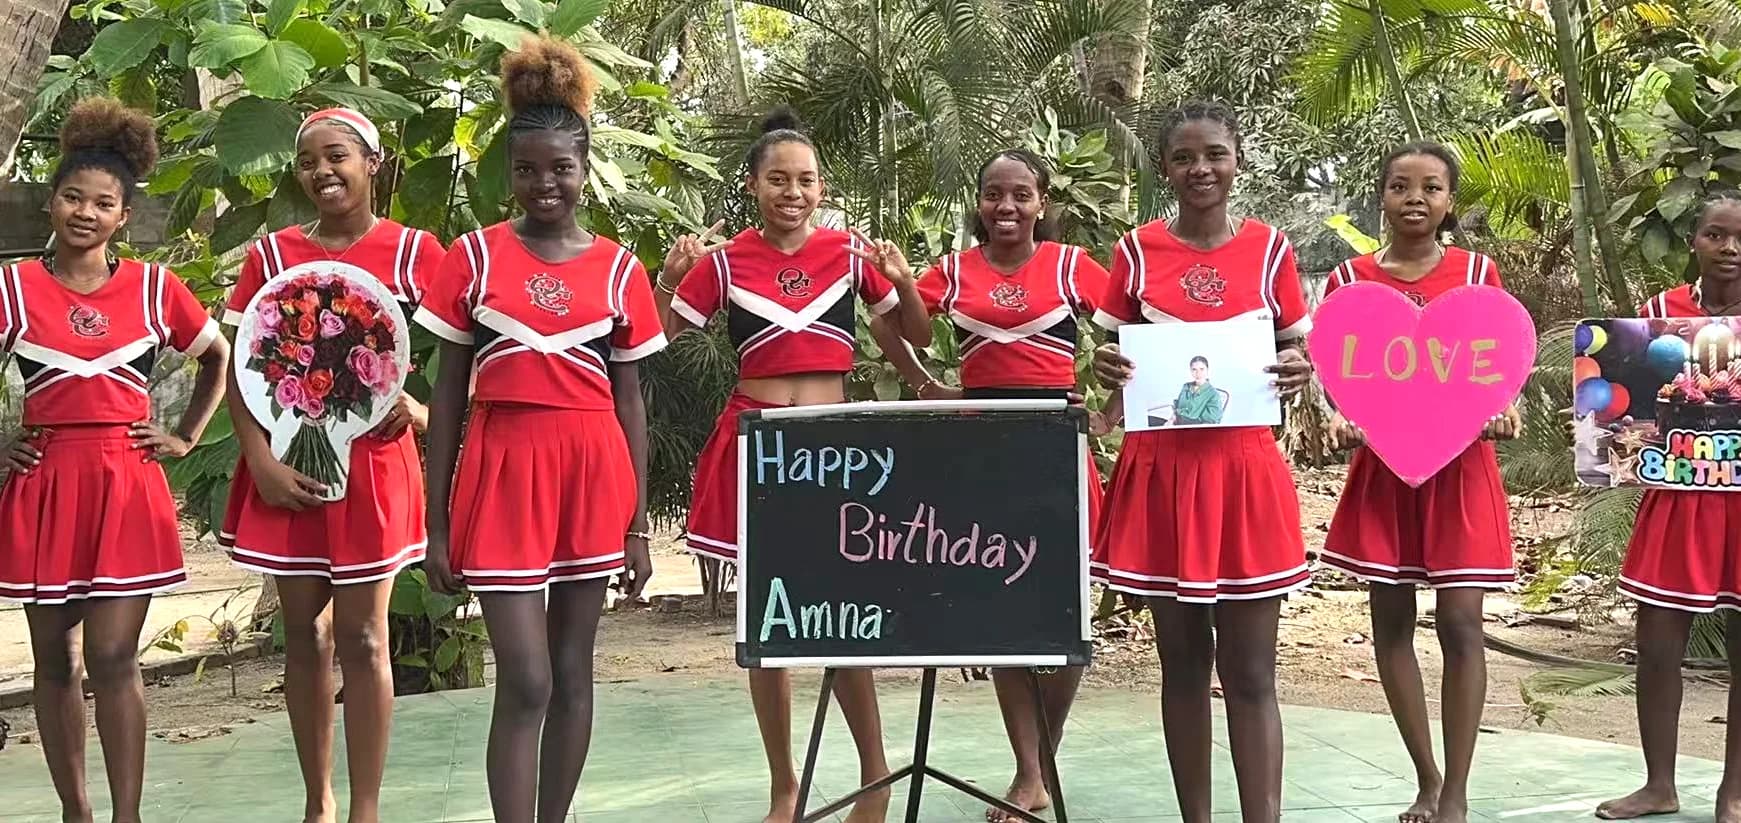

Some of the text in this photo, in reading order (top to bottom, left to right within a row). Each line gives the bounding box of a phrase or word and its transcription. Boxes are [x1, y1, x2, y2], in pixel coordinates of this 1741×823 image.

[1341, 333, 1504, 385] LOVE
[754, 430, 895, 496] Happy
[1671, 431, 1741, 460] HAPP
[839, 501, 1037, 585] Birthday
[759, 576, 883, 642] Amna
